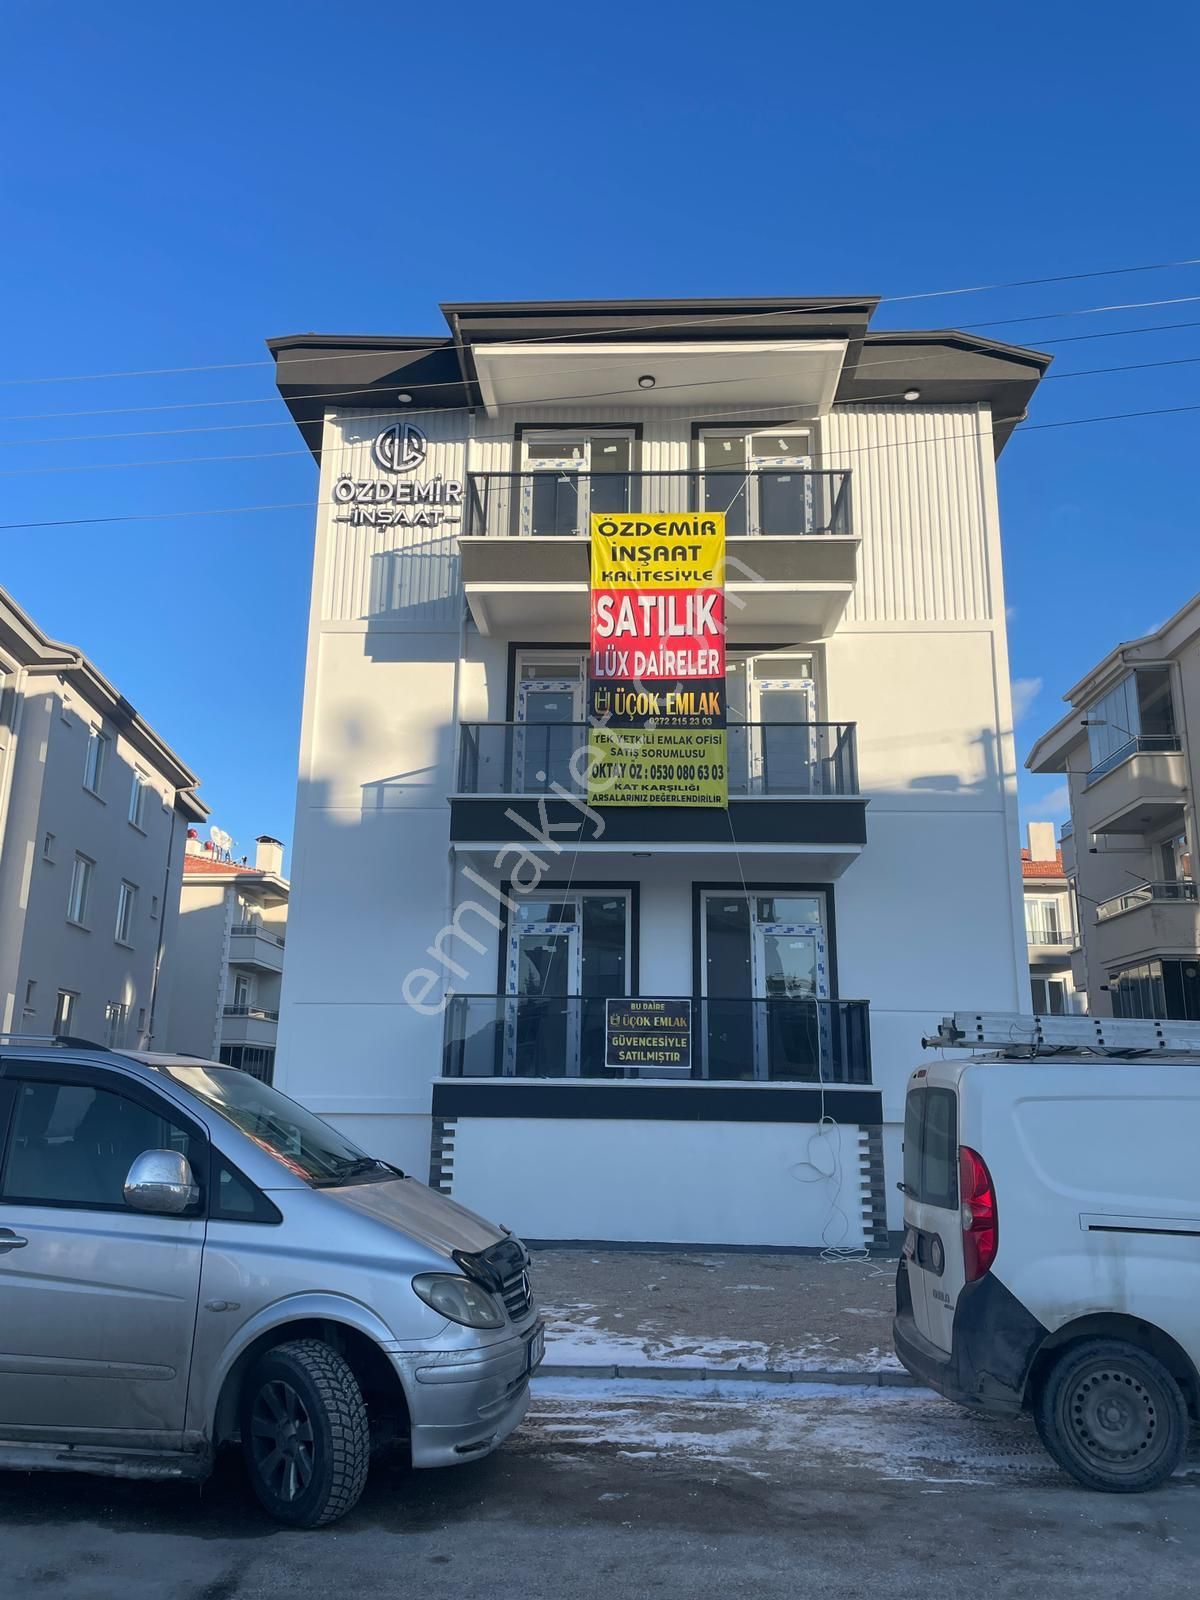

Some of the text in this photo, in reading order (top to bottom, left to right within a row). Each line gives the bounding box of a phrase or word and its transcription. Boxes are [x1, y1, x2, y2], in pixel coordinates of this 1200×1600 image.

[335, 473, 462, 502] ÖZDEMİR
[353, 504, 444, 529] İNŞAAT
[598, 517, 717, 537] ÖZDEMİR
[611, 542, 702, 566] İNŞAAT
[601, 568, 713, 582] KALİTESİYLE
[596, 594, 719, 637] SATILIK
[595, 644, 720, 677] LÜX DAİRELER
[615, 688, 721, 721] ÜÇOK EMLAK
[650, 717, 713, 726] 0272 215 23 03
[594, 734, 722, 745] TEK YETKİLİ EMLAK OFİSİ
[610, 748, 706, 759] SATIŞ SORUMLUSU
[592, 763, 627, 779] OKTAY
[629, 760, 642, 779] ÖZ
[650, 764, 675, 780] 0530
[677, 764, 695, 780] 080
[697, 764, 709, 780] 63
[711, 764, 724, 780] 03
[614, 783, 700, 792] KAT KARŞILIĞI
[592, 793, 722, 803] ARSALARINIZ DEĞERLENDİRİLİR
[643, 1002, 665, 1011] DAİRE
[623, 1014, 687, 1028] ÜÇOK EMLAK
[612, 1035, 687, 1047] GÜVENCESİYLE
[618, 1051, 680, 1063] SATILMIŞTIR
